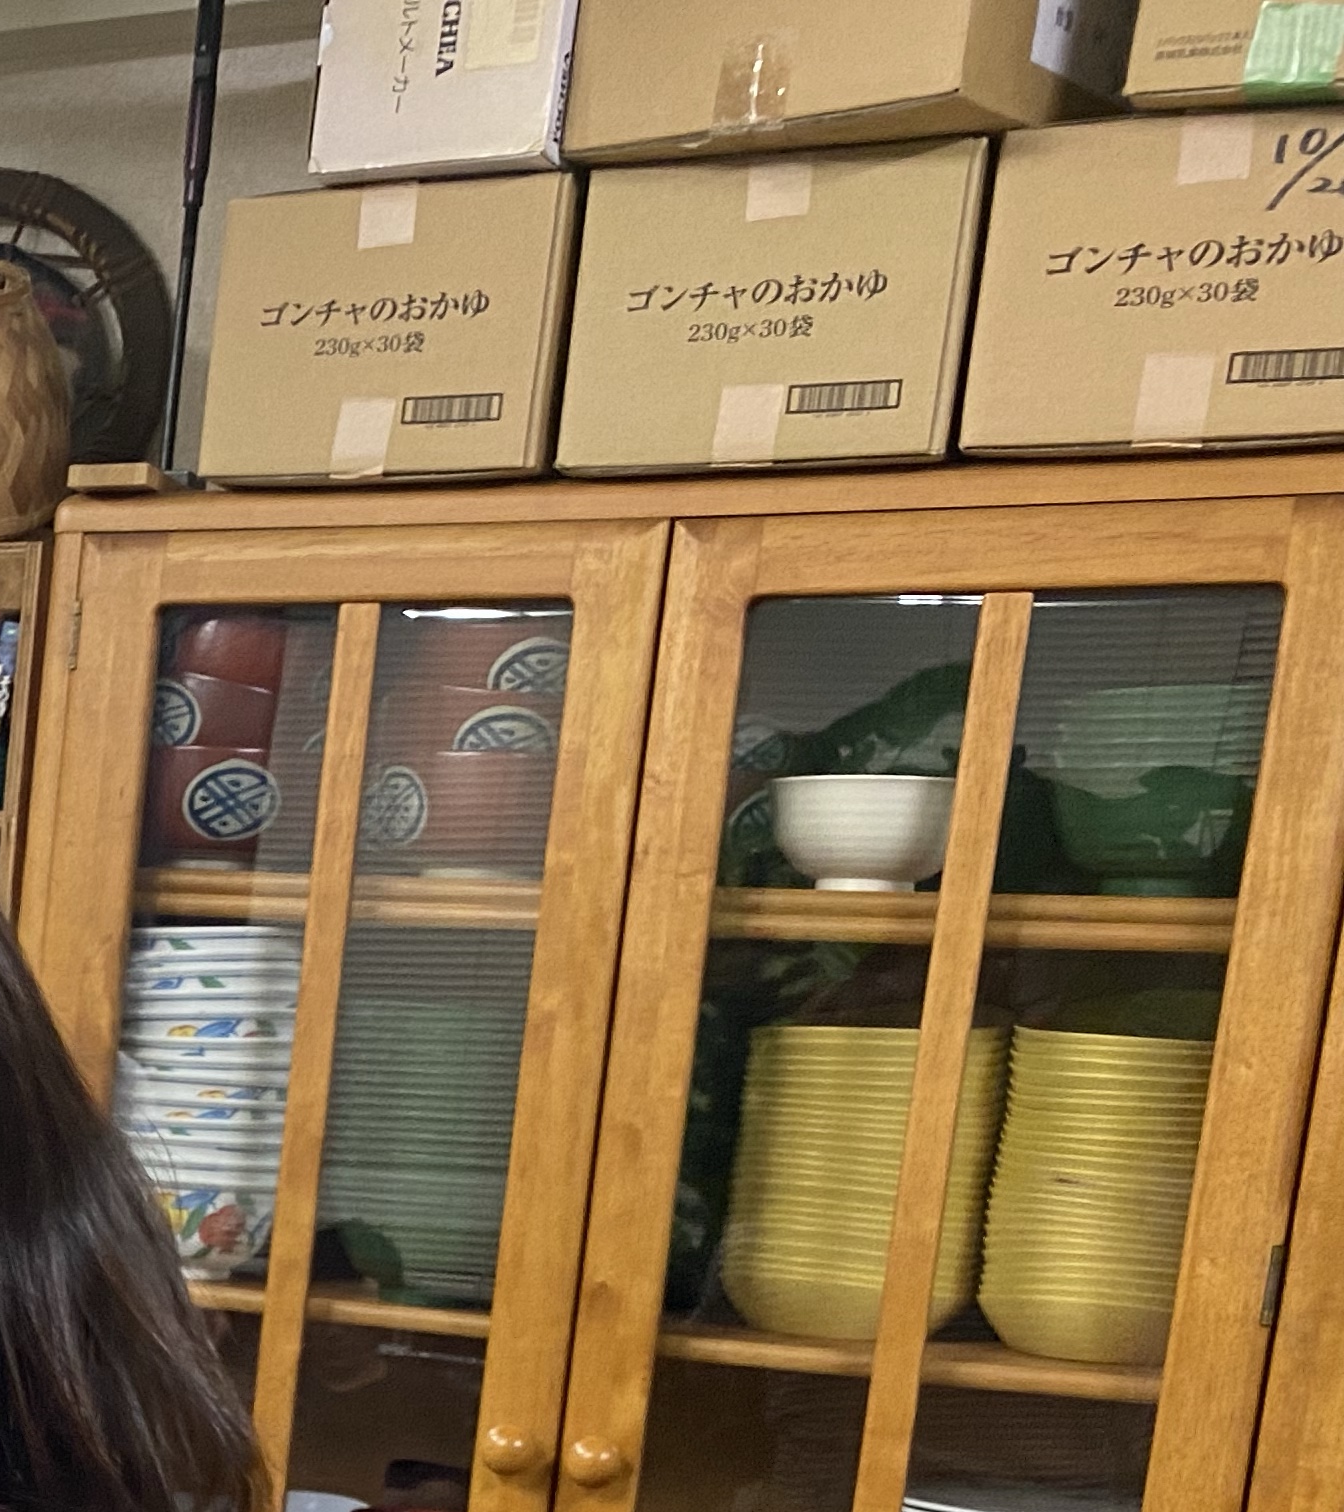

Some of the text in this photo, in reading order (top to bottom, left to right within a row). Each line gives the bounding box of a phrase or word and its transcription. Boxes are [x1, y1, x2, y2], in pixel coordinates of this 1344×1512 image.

[1045, 228, 1343, 276] ゴンチャのおかゆ
[626, 268, 888, 312] ゴンチャのおかゆ
[1113, 278, 1261, 309] 230g×30袋
[260, 289, 490, 327] ゴンチャのおかゆ
[313, 330, 425, 358] 230g×30袋
[687, 313, 814, 344] 230g×30袋
